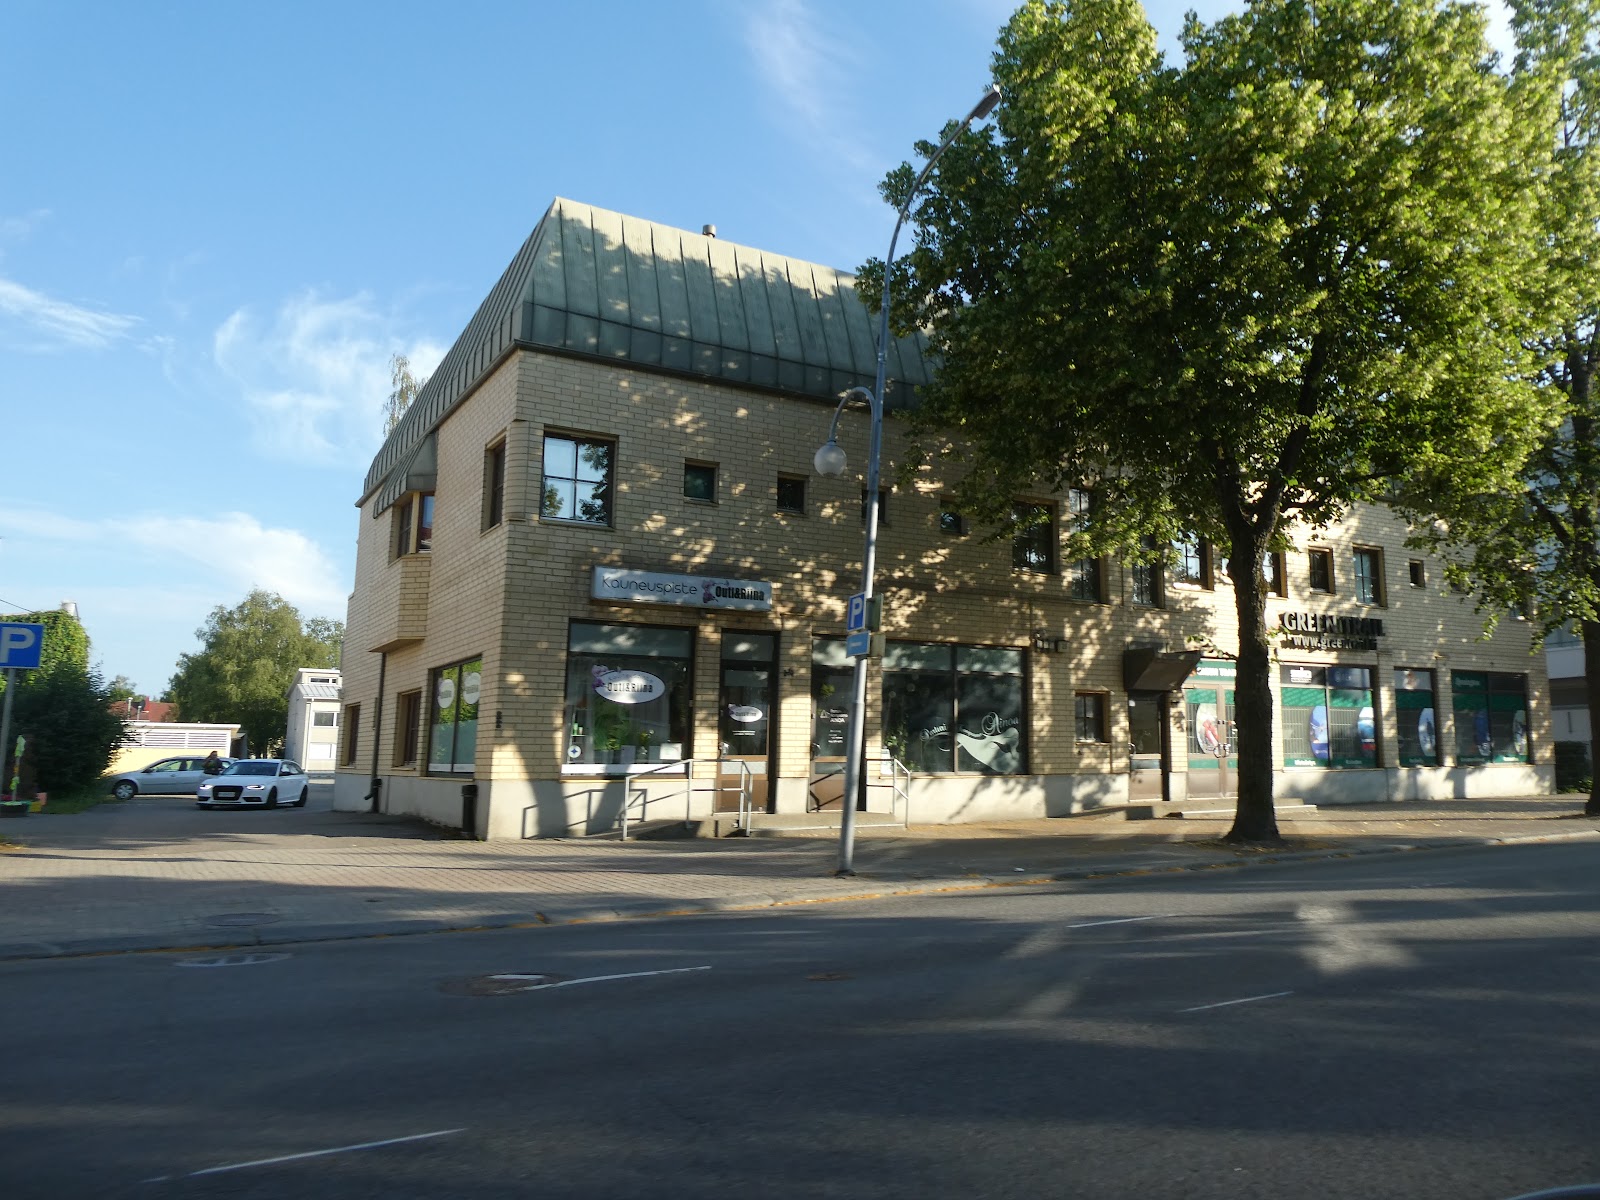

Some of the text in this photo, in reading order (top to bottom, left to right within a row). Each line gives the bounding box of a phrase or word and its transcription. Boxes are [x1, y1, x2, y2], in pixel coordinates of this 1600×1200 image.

[602, 576, 765, 601] Kauneuspiste Outi&Riina
[850, 597, 863, 628] P
[0, 627, 35, 664] P
